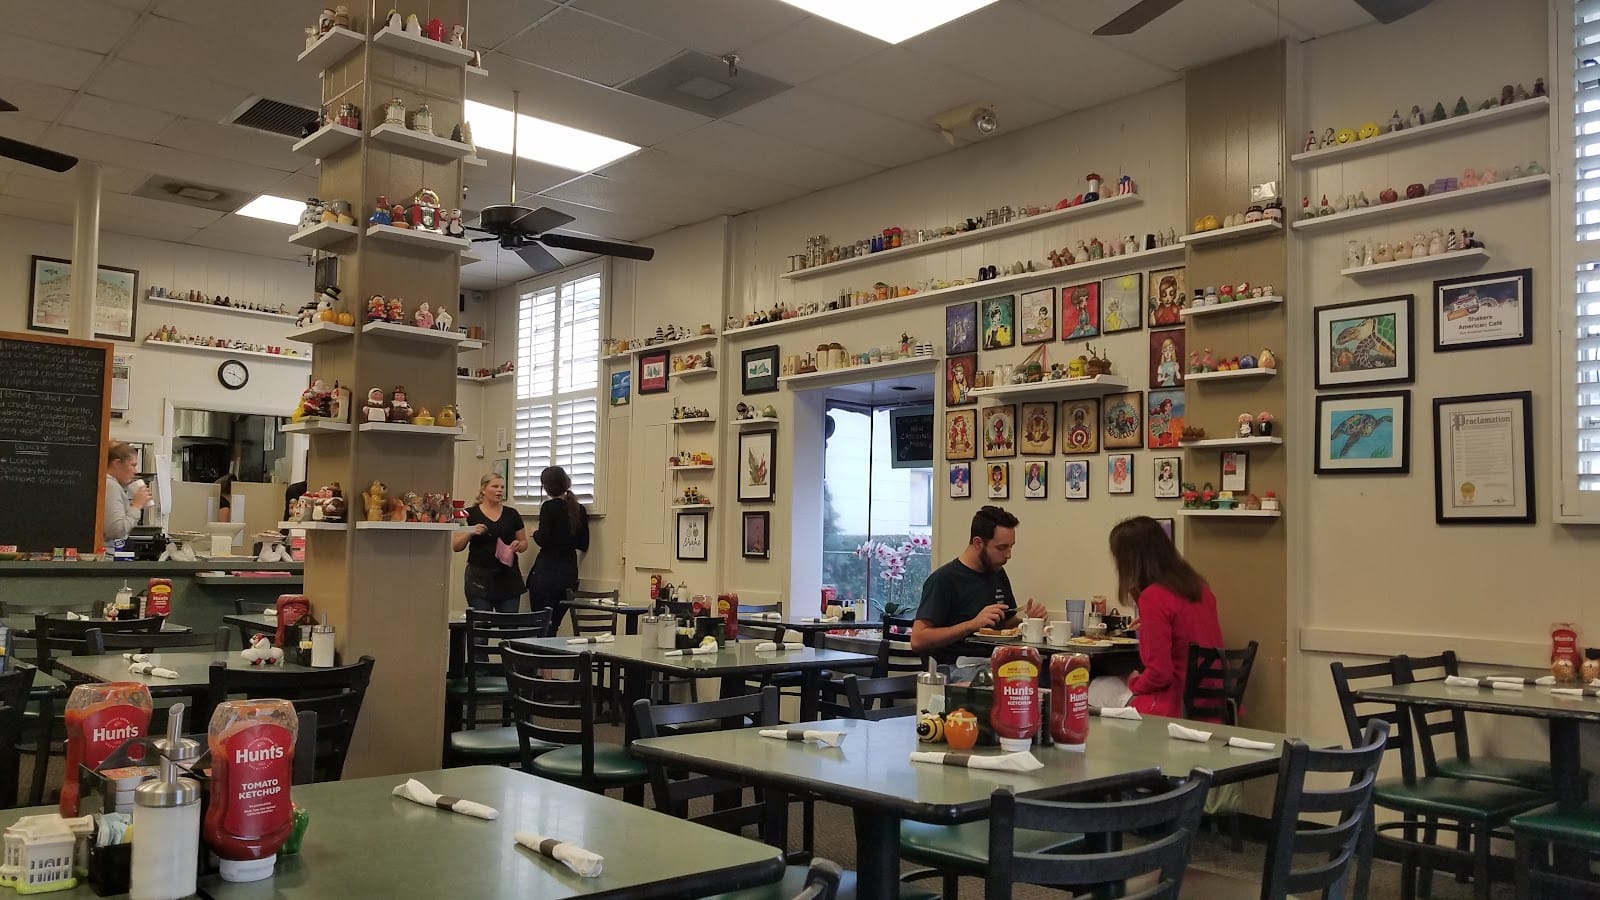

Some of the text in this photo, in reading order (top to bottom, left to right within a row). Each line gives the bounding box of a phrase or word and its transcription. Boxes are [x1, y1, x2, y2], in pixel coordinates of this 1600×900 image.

[1452, 413, 1511, 431] Proclamation
[241, 778, 279, 791] TOMATO
[238, 786, 281, 800] KETCHUP
